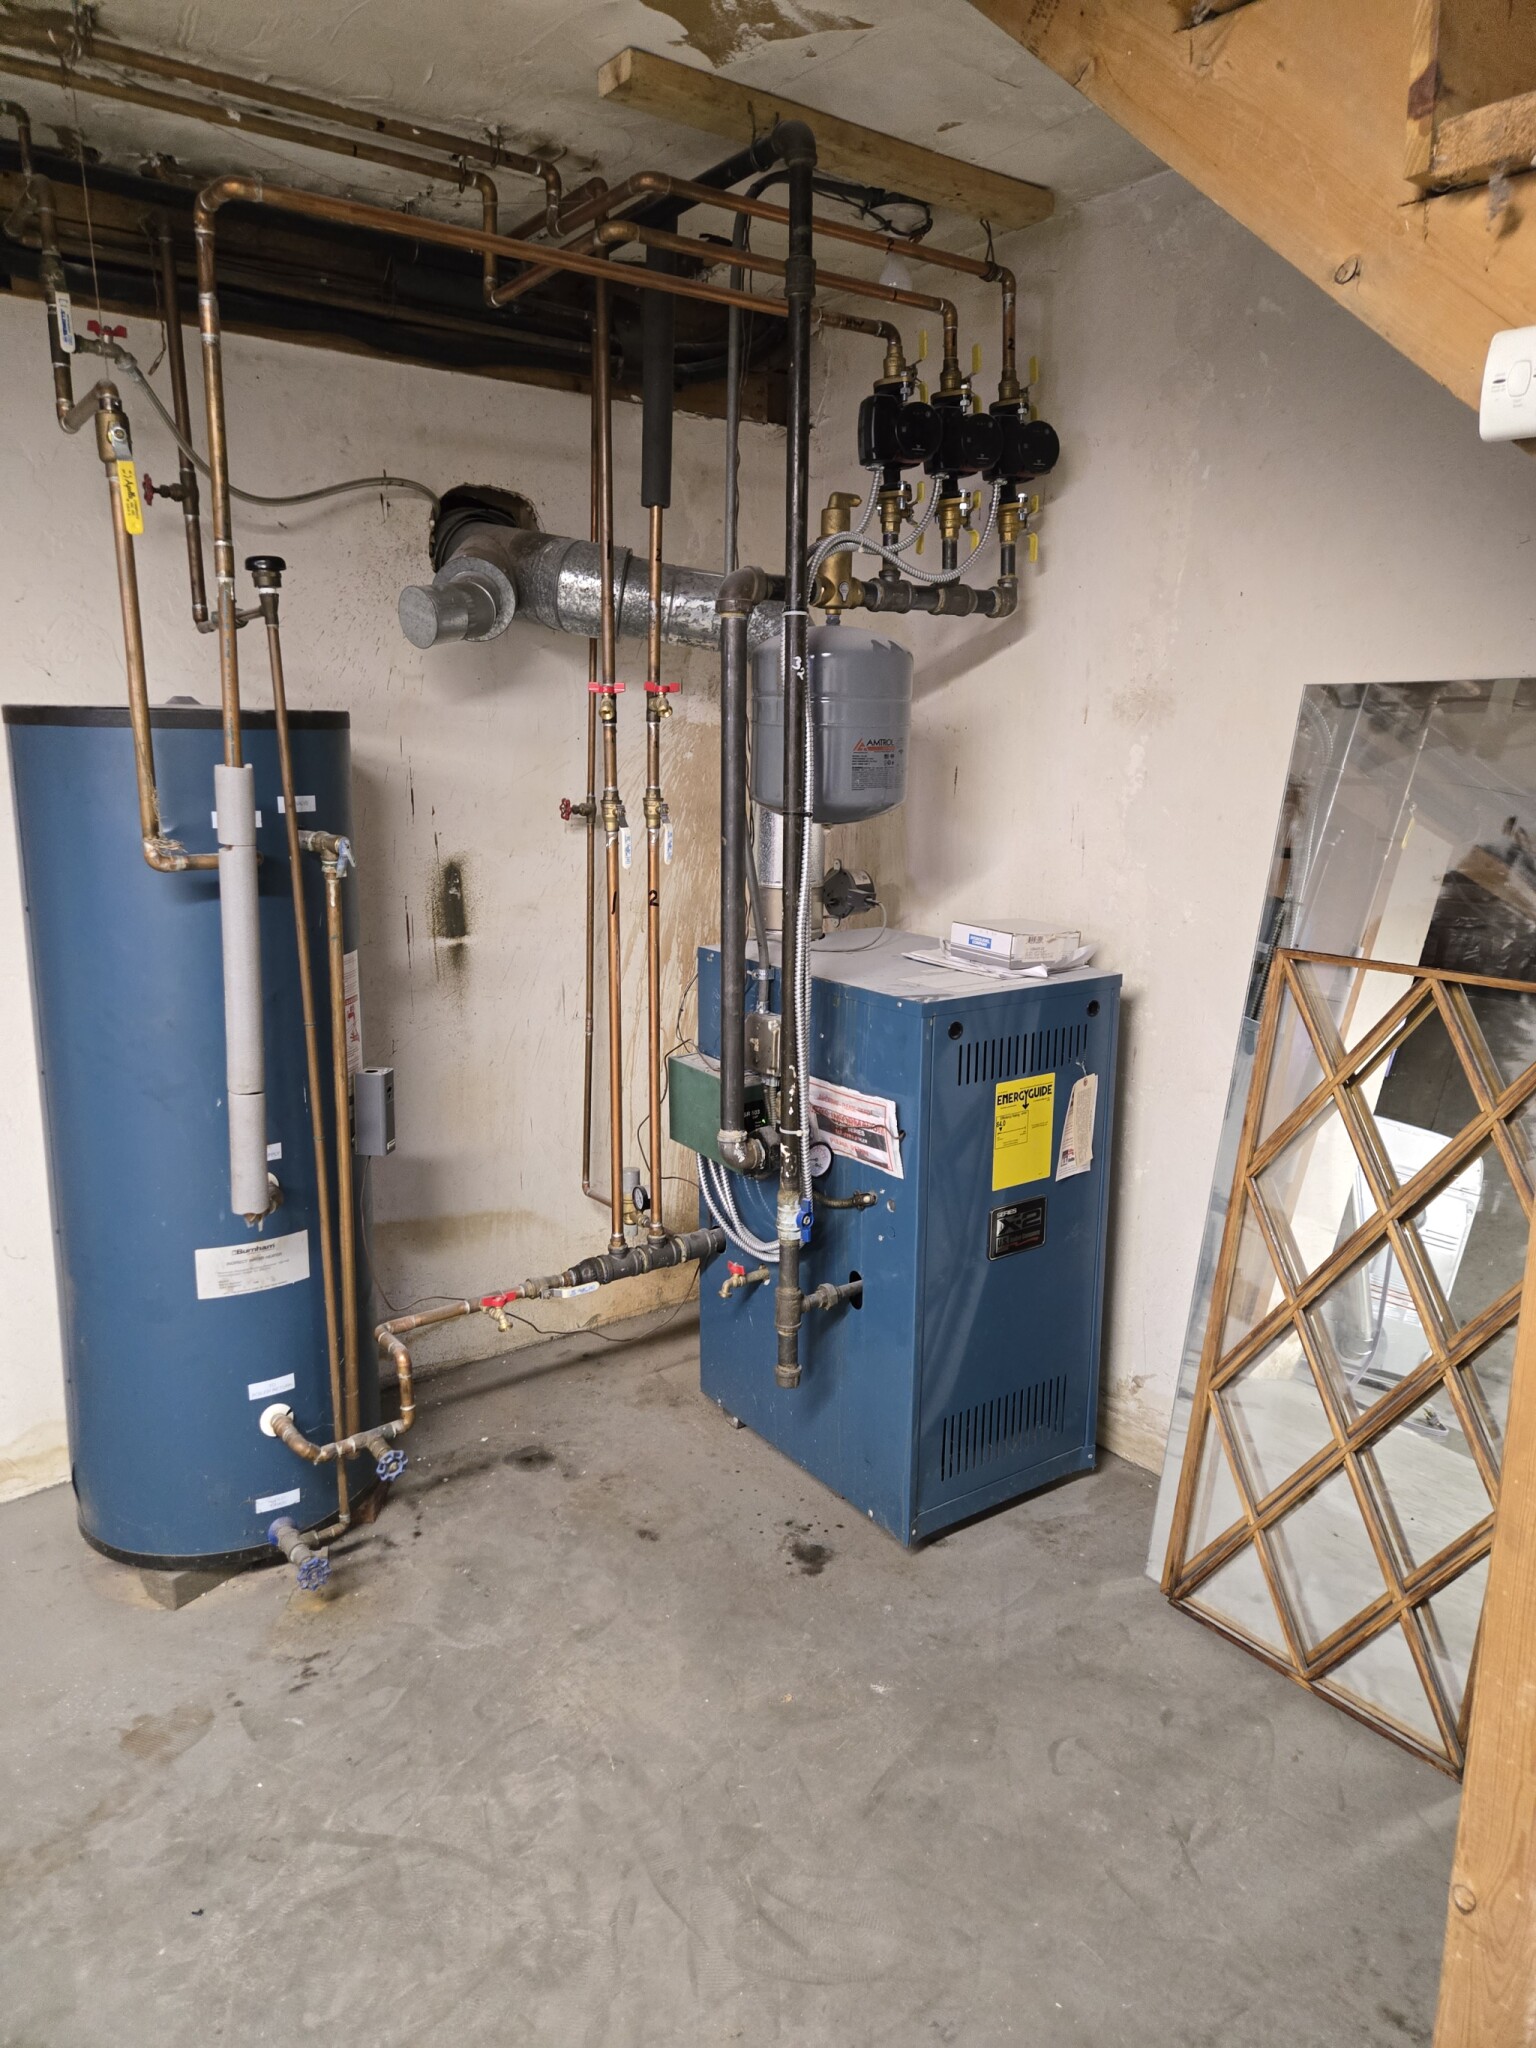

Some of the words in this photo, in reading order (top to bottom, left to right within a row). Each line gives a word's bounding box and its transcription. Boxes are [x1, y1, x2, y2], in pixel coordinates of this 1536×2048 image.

[1007, 337, 1016, 350] 2
[866, 738, 895, 746] AMTROL
[611, 891, 617, 915] 1
[648, 889, 660, 907] 2
[997, 1084, 1053, 1105] ENERGYGUIDE
[997, 1208, 1017, 1218] SERIES
[236, 1243, 276, 1255] Burnham
